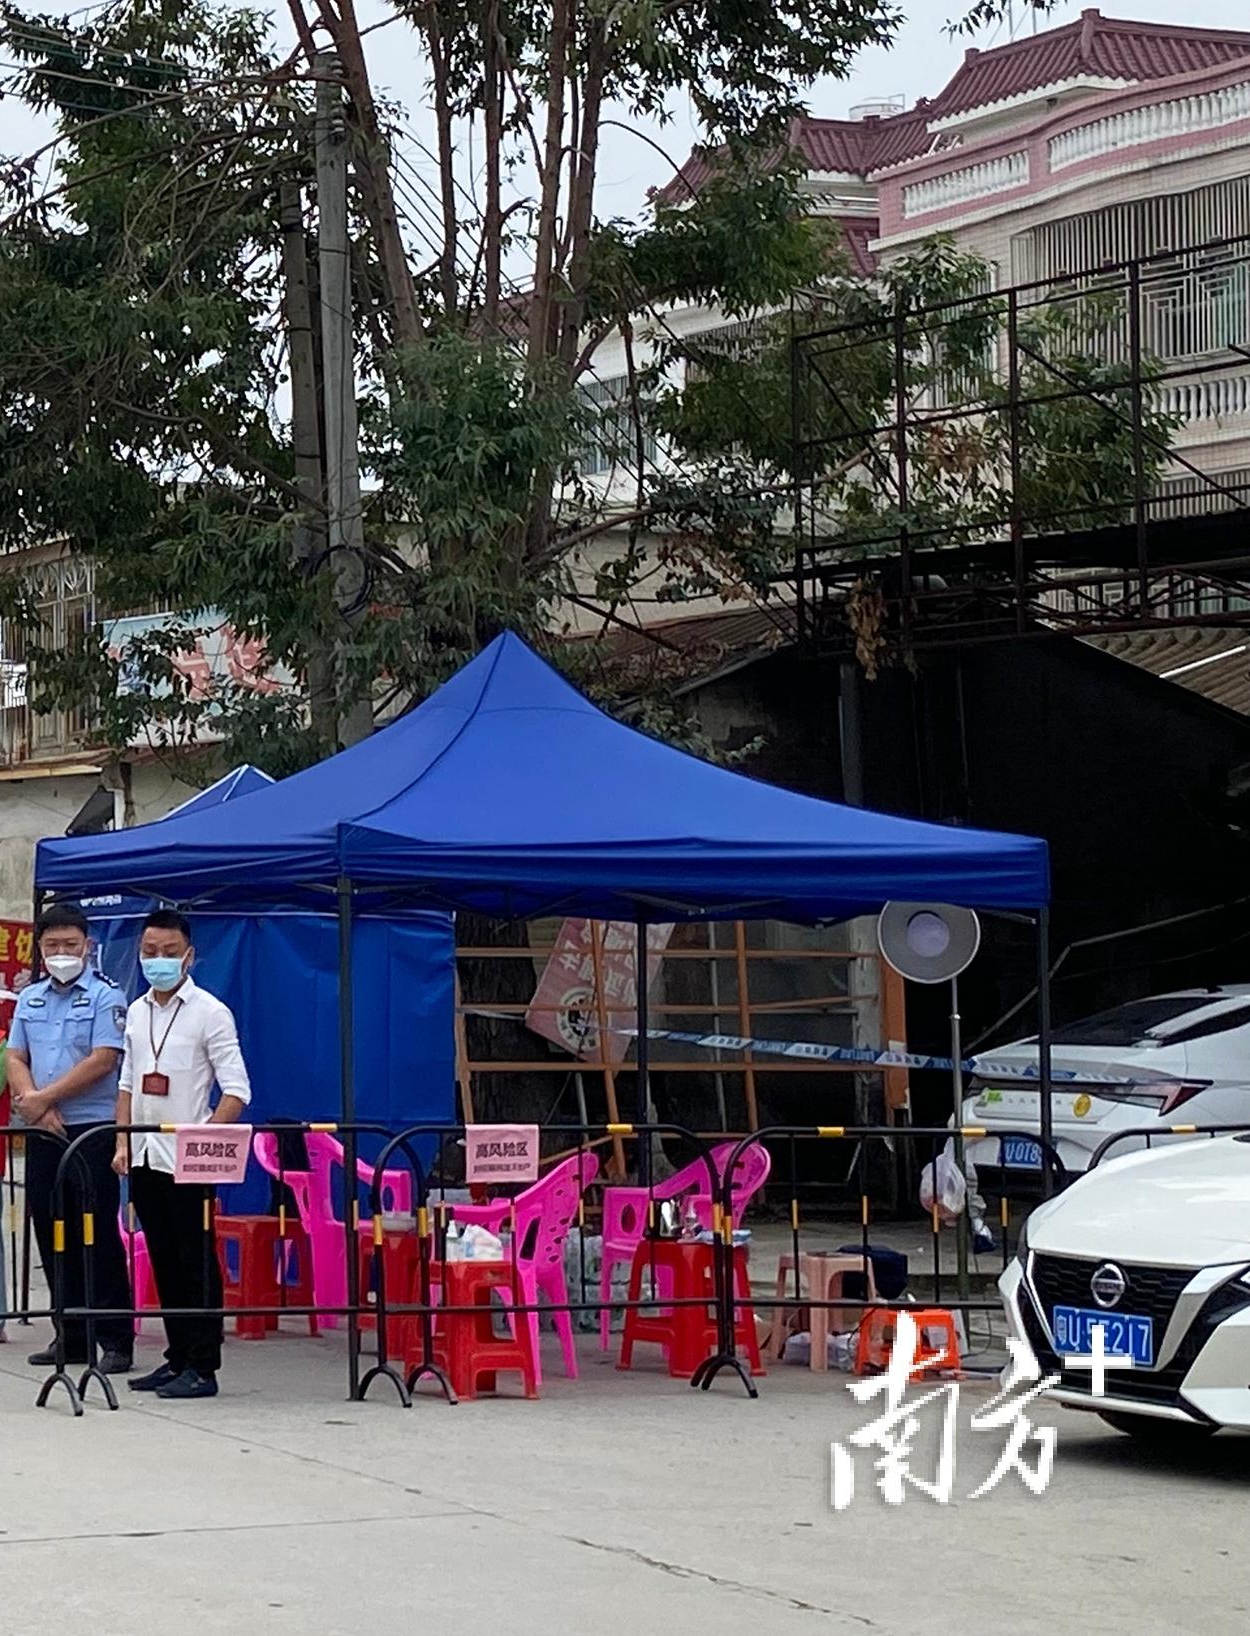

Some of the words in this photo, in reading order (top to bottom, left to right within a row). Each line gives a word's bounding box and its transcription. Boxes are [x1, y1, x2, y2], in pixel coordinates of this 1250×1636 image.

[184, 1142, 238, 1158] 高风险区
[475, 1141, 528, 1158] 高风险区
